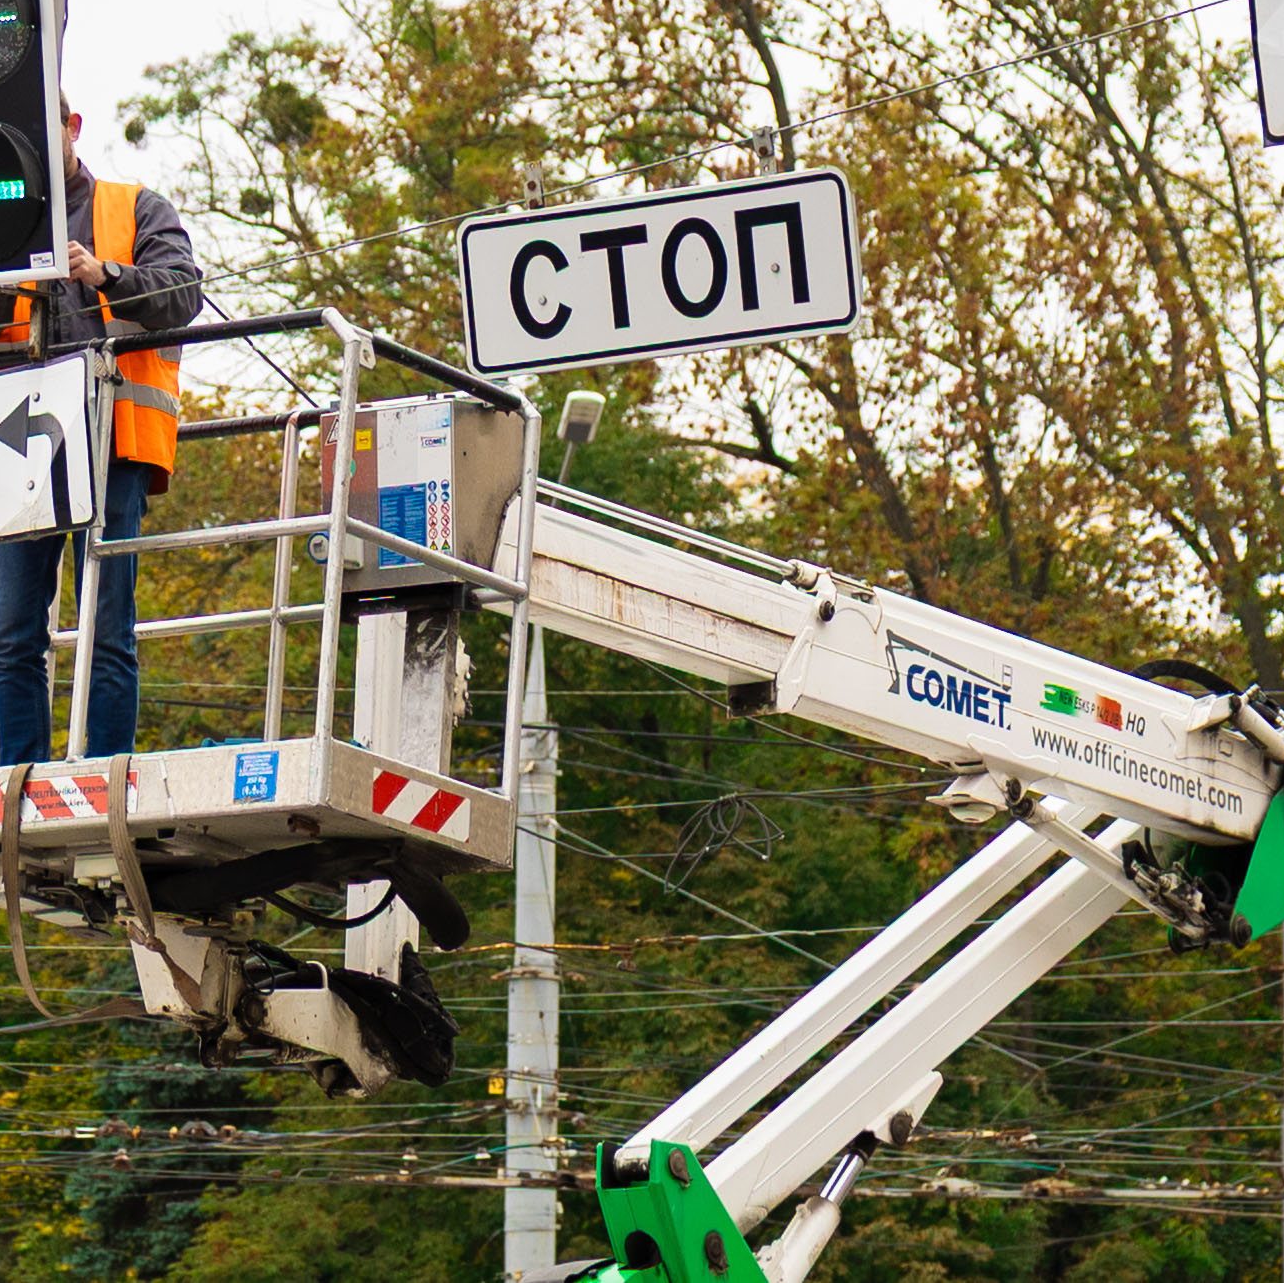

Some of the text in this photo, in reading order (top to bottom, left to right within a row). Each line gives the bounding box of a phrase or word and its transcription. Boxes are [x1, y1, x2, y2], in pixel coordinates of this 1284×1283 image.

[509, 201, 811, 340] СТОП
[1126, 711, 1146, 737] HQ
[1031, 726, 1244, 816] www.officinecomet.com
